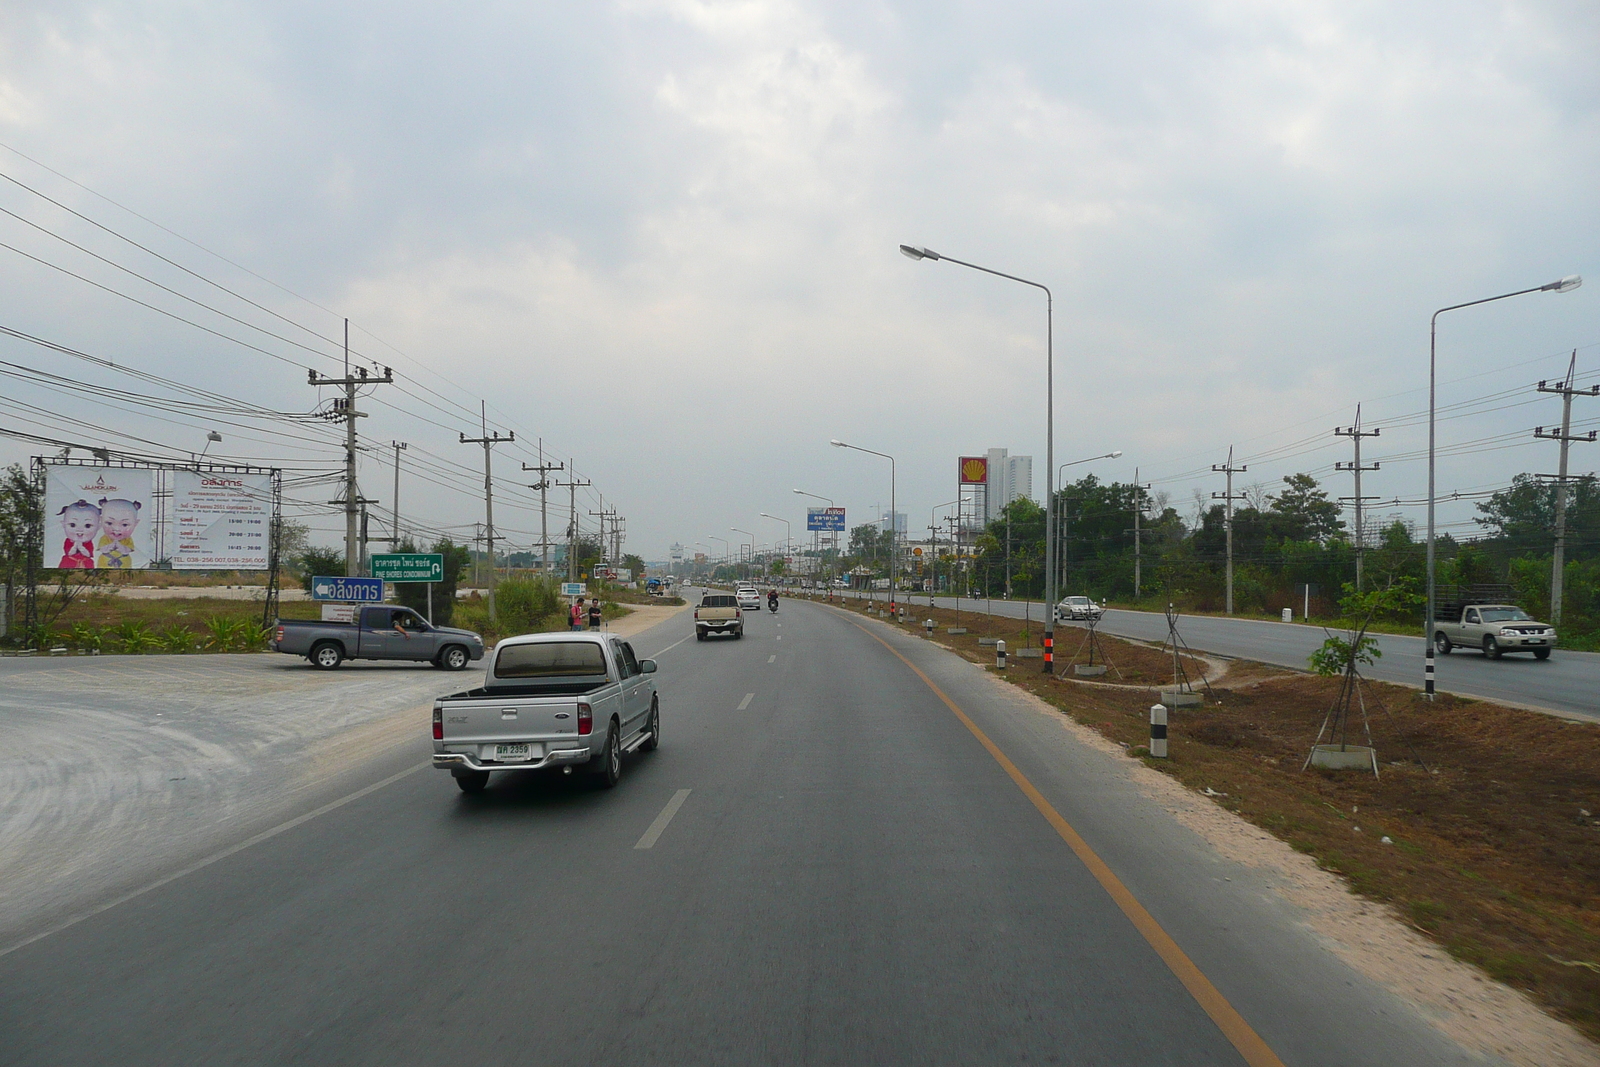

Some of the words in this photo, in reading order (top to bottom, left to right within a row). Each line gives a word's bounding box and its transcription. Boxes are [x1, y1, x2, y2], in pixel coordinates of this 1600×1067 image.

[201, 478, 243, 486] อลังการ
[375, 560, 400, 570] อาคารชุด
[402, 556, 414, 567] ไพน์
[328, 580, 378, 600] อลังการ
[510, 745, 528, 754] 2359
